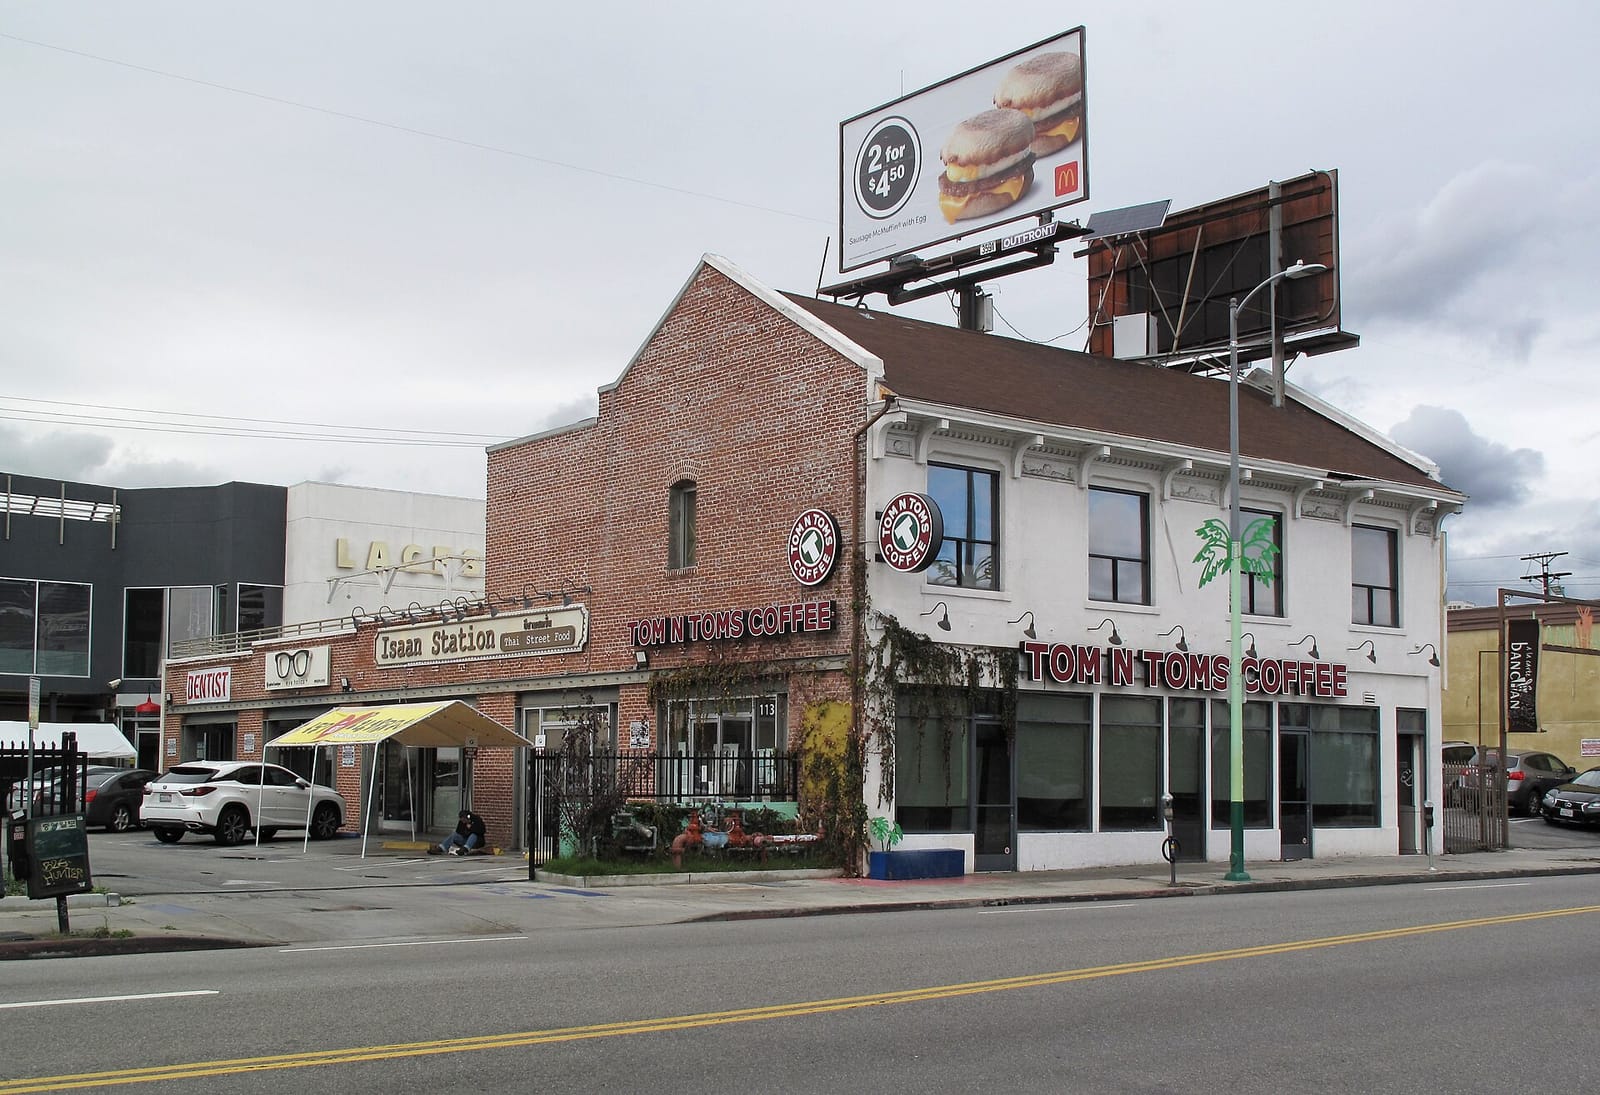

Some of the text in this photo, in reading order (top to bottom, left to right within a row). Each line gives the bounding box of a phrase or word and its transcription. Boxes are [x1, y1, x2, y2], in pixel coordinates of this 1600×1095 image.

[868, 144, 906, 174] 2 for
[849, 231, 873, 246] Sausage
[902, 217, 915, 228] with
[915, 215, 927, 225] Egg
[1003, 223, 1055, 248] OUTFRONT
[882, 497, 930, 538] TOM N TOMS
[790, 513, 833, 555] TOM N TOMS
[793, 553, 831, 580] COFFEE
[885, 540, 926, 566] COFFEE
[627, 600, 831, 646] TOM N TOMS COFFEE
[381, 625, 496, 660] Isaan Station
[504, 630, 570, 647] Thai Street Food
[1025, 642, 1348, 697] TOM N TOMS COFFEE
[187, 671, 229, 700] DENTIST
[760, 703, 775, 716] 113
